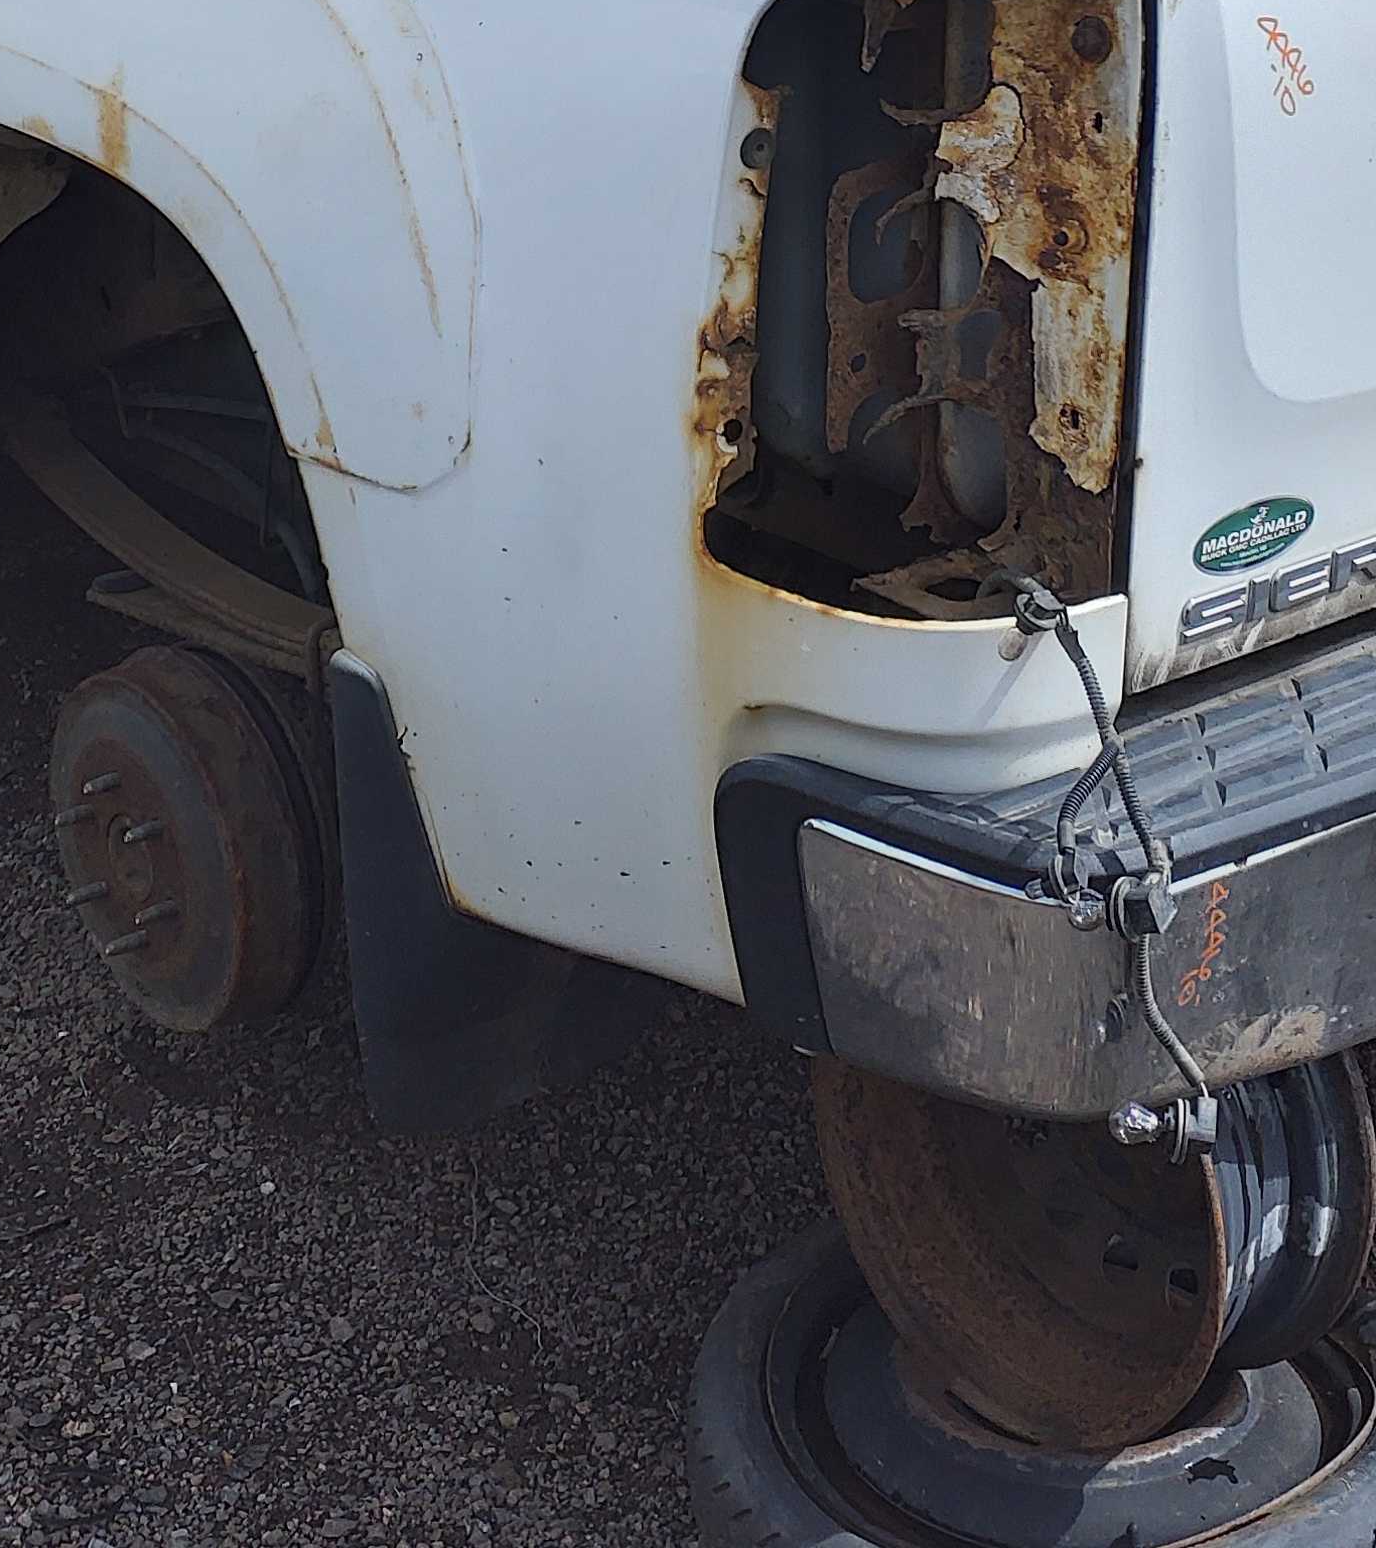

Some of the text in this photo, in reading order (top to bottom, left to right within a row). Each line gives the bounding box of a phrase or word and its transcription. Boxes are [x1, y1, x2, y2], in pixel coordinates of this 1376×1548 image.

[1200, 548, 1228, 562] BUICK
[1228, 542, 1249, 553] GMC
[1250, 527, 1290, 547] CADILLAC
[1202, 510, 1307, 554] MACDONALD
